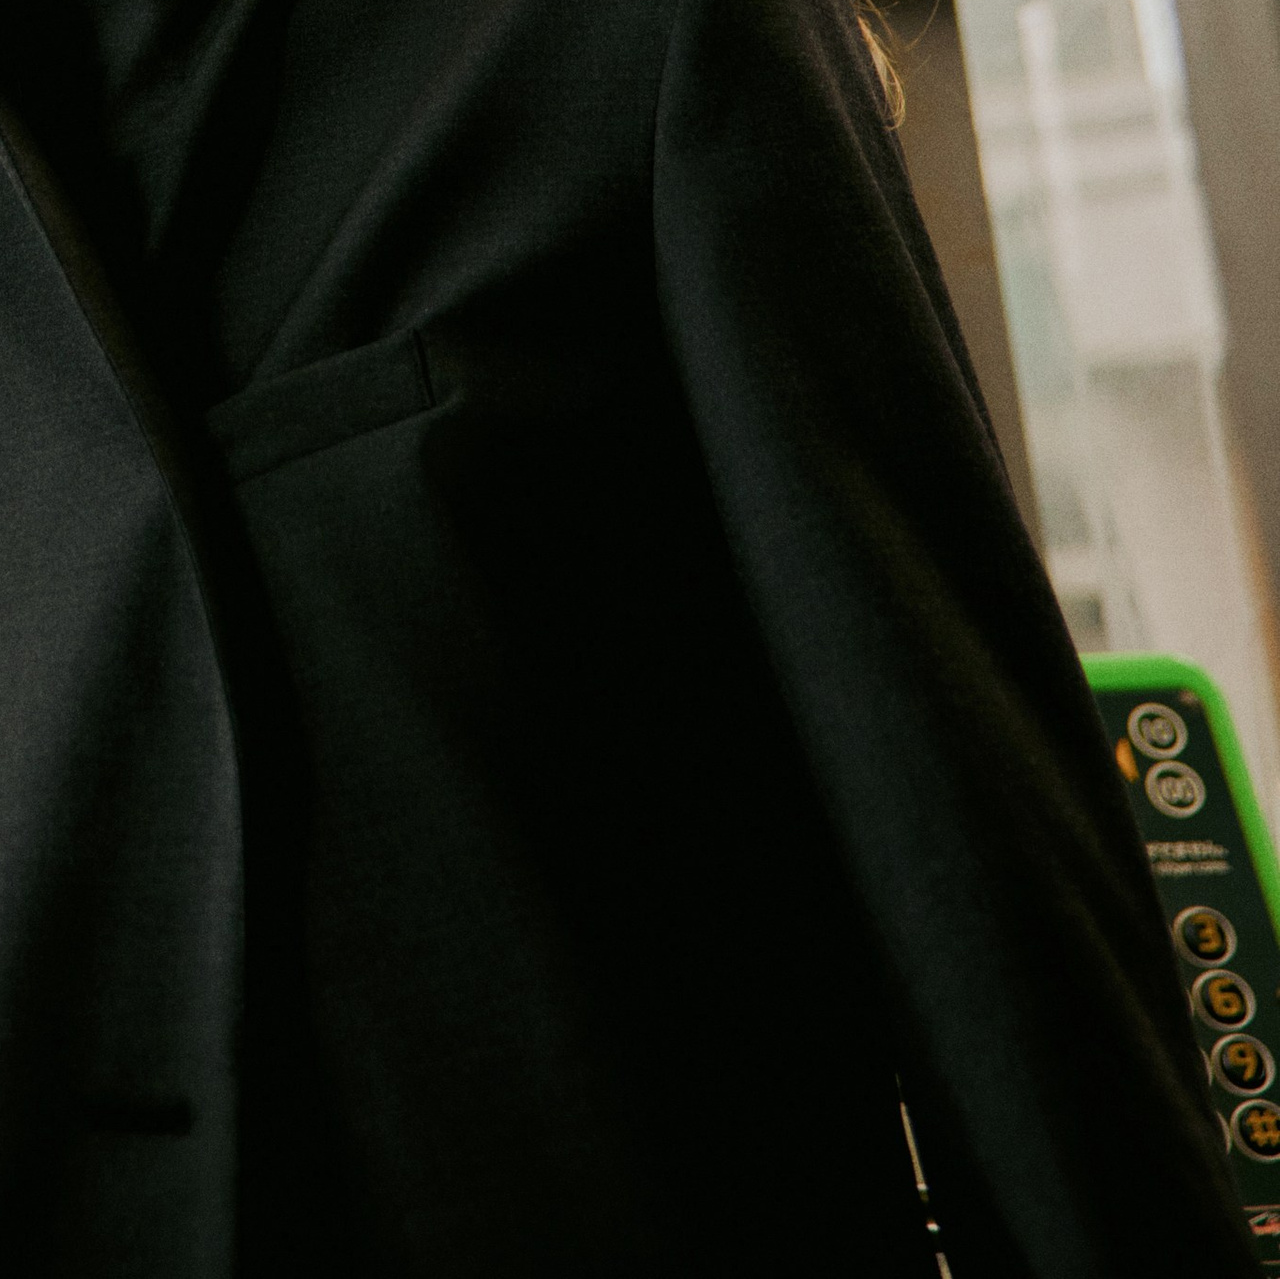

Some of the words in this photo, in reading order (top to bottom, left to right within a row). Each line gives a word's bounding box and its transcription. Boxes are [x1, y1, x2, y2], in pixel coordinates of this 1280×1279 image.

[1190, 913, 1221, 953] 3
[1208, 976, 1243, 1018] 6
[1228, 1042, 1258, 1082] 9
